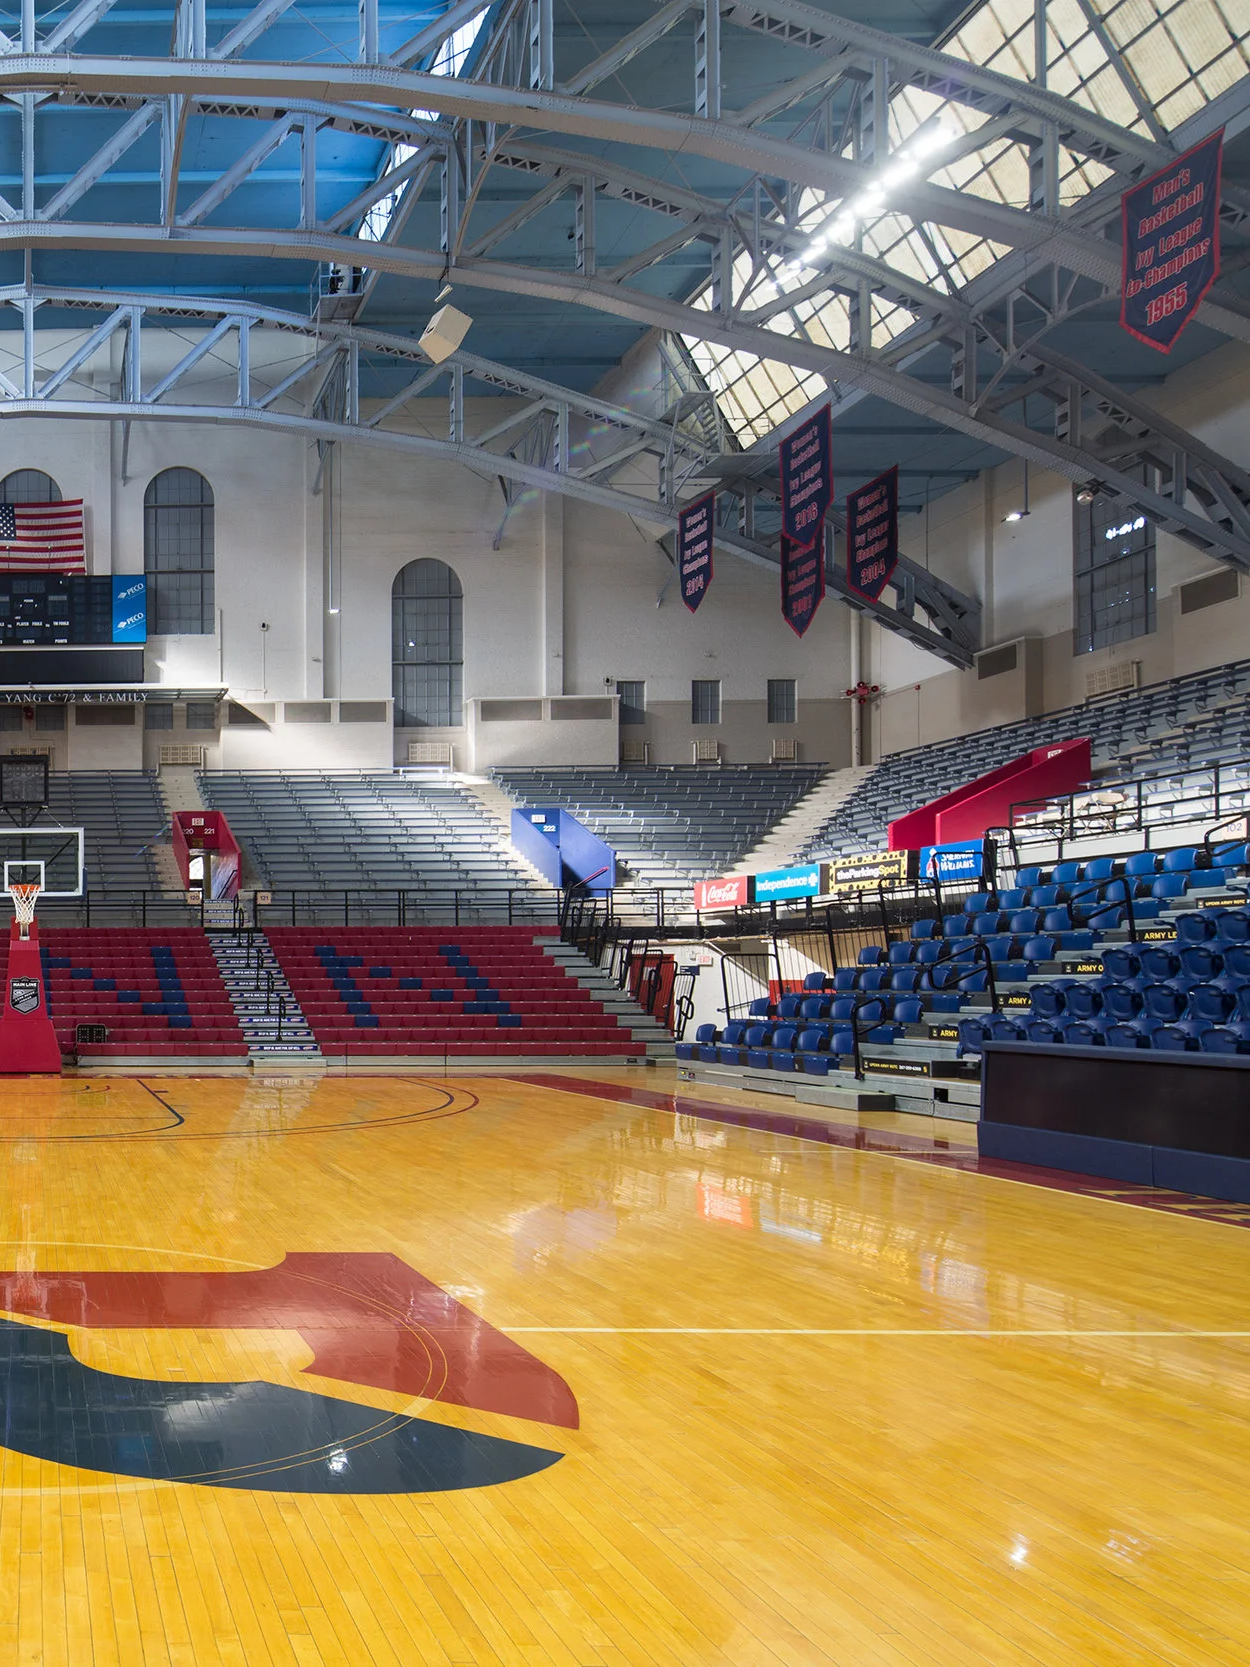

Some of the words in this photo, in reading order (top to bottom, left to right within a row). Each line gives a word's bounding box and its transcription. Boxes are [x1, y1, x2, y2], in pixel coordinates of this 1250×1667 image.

[1152, 168, 1190, 205] Men's
[1138, 181, 1204, 239] Basketball
[1135, 245, 1155, 271] Ivy
[1158, 216, 1203, 257] League
[1145, 281, 1188, 326] 1955
[795, 501, 818, 531] 2016
[860, 558, 886, 586] 2004
[126, 582, 144, 595] PECO
[686, 573, 704, 596] 2014
[126, 612, 144, 625] PECO
[5, 693, 42, 704] YANG
[82, 693, 92, 703] &
[99, 692, 149, 703] FAMILY
[1226, 822, 1243, 833] 102
[836, 863, 899, 881] theParkingSpot
[757, 876, 808, 892] Independence
[1144, 932, 1166, 940] ARMY
[1077, 964, 1097, 972] ARMY
